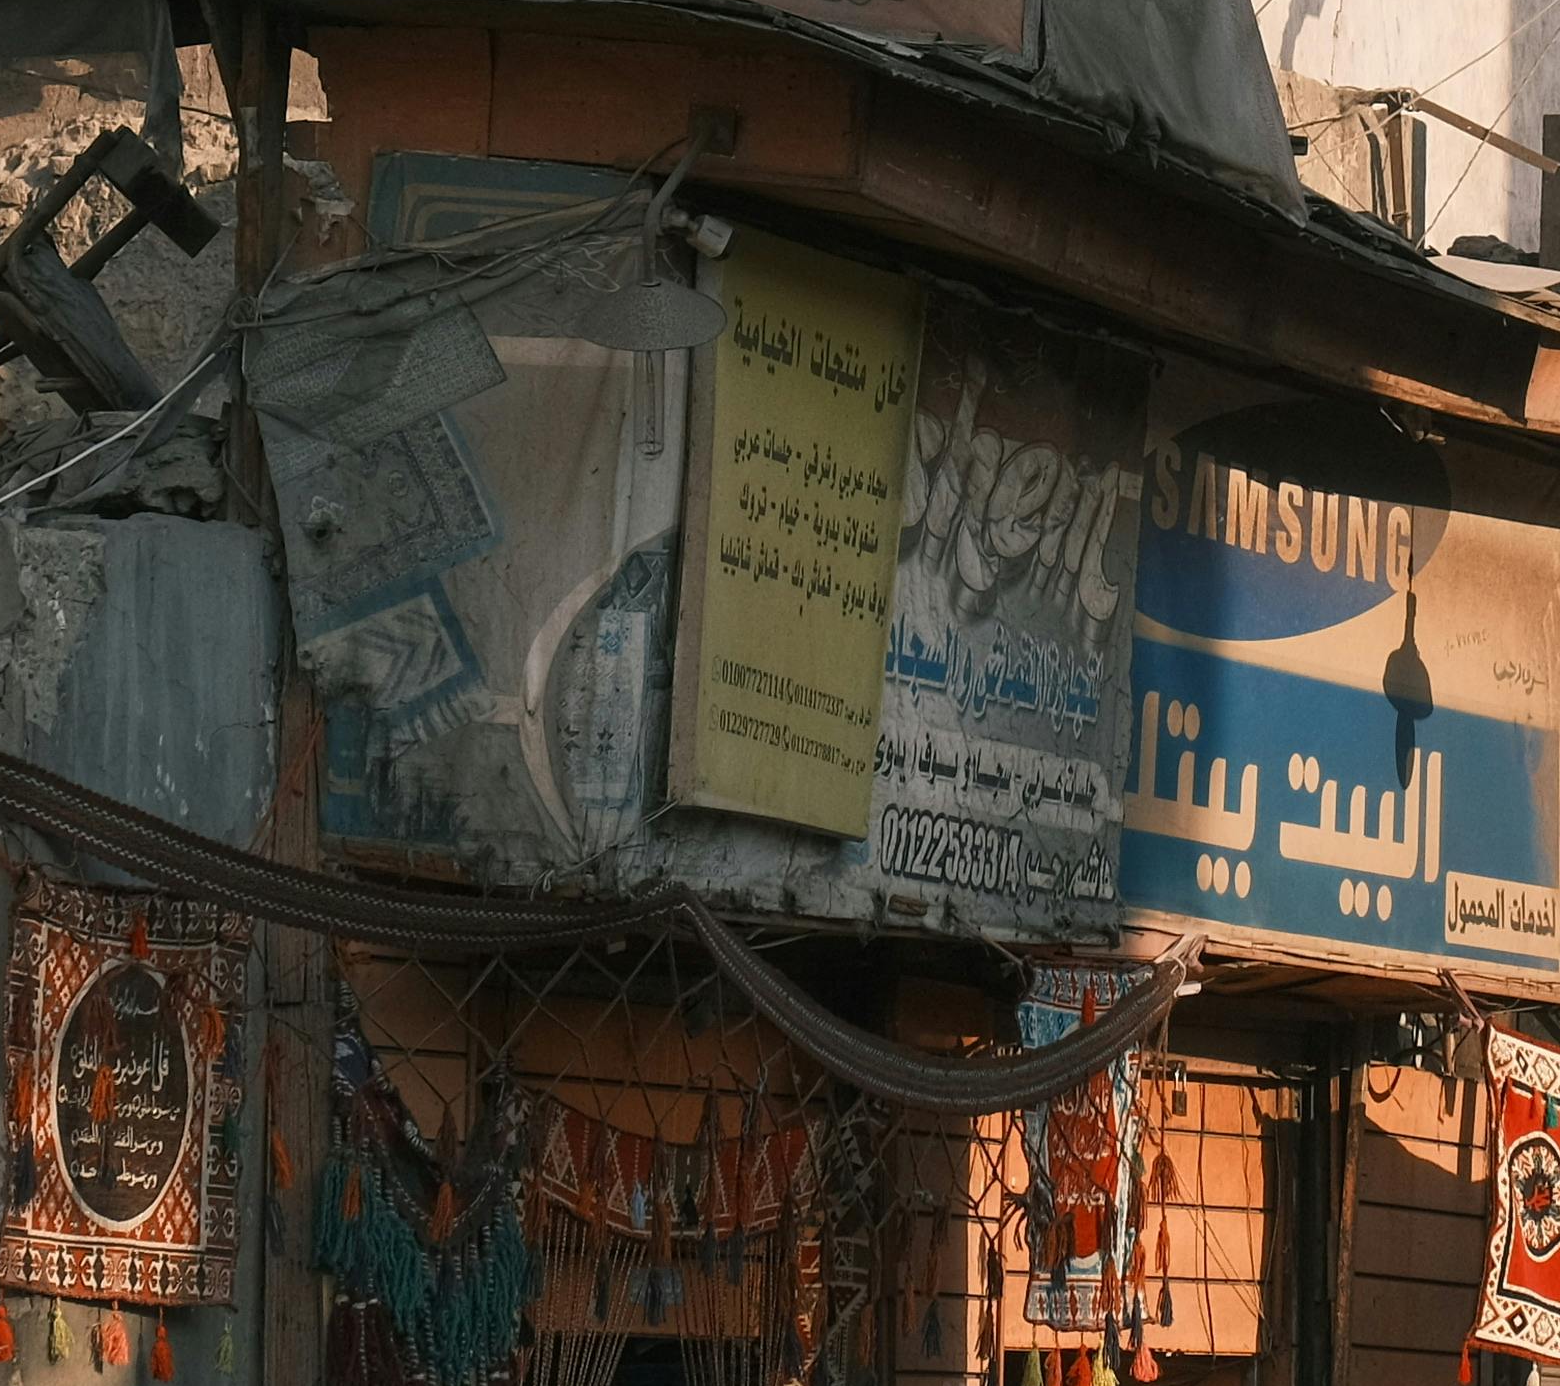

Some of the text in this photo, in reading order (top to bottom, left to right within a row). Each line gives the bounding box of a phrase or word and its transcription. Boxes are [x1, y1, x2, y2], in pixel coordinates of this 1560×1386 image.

[733, 294, 908, 413] خان منتجات الخيامية
[1150, 439, 1412, 592] SAMSUNG
[1279, 747, 1443, 922] البيت
[1445, 879, 1557, 940] لخدمات المحمول
